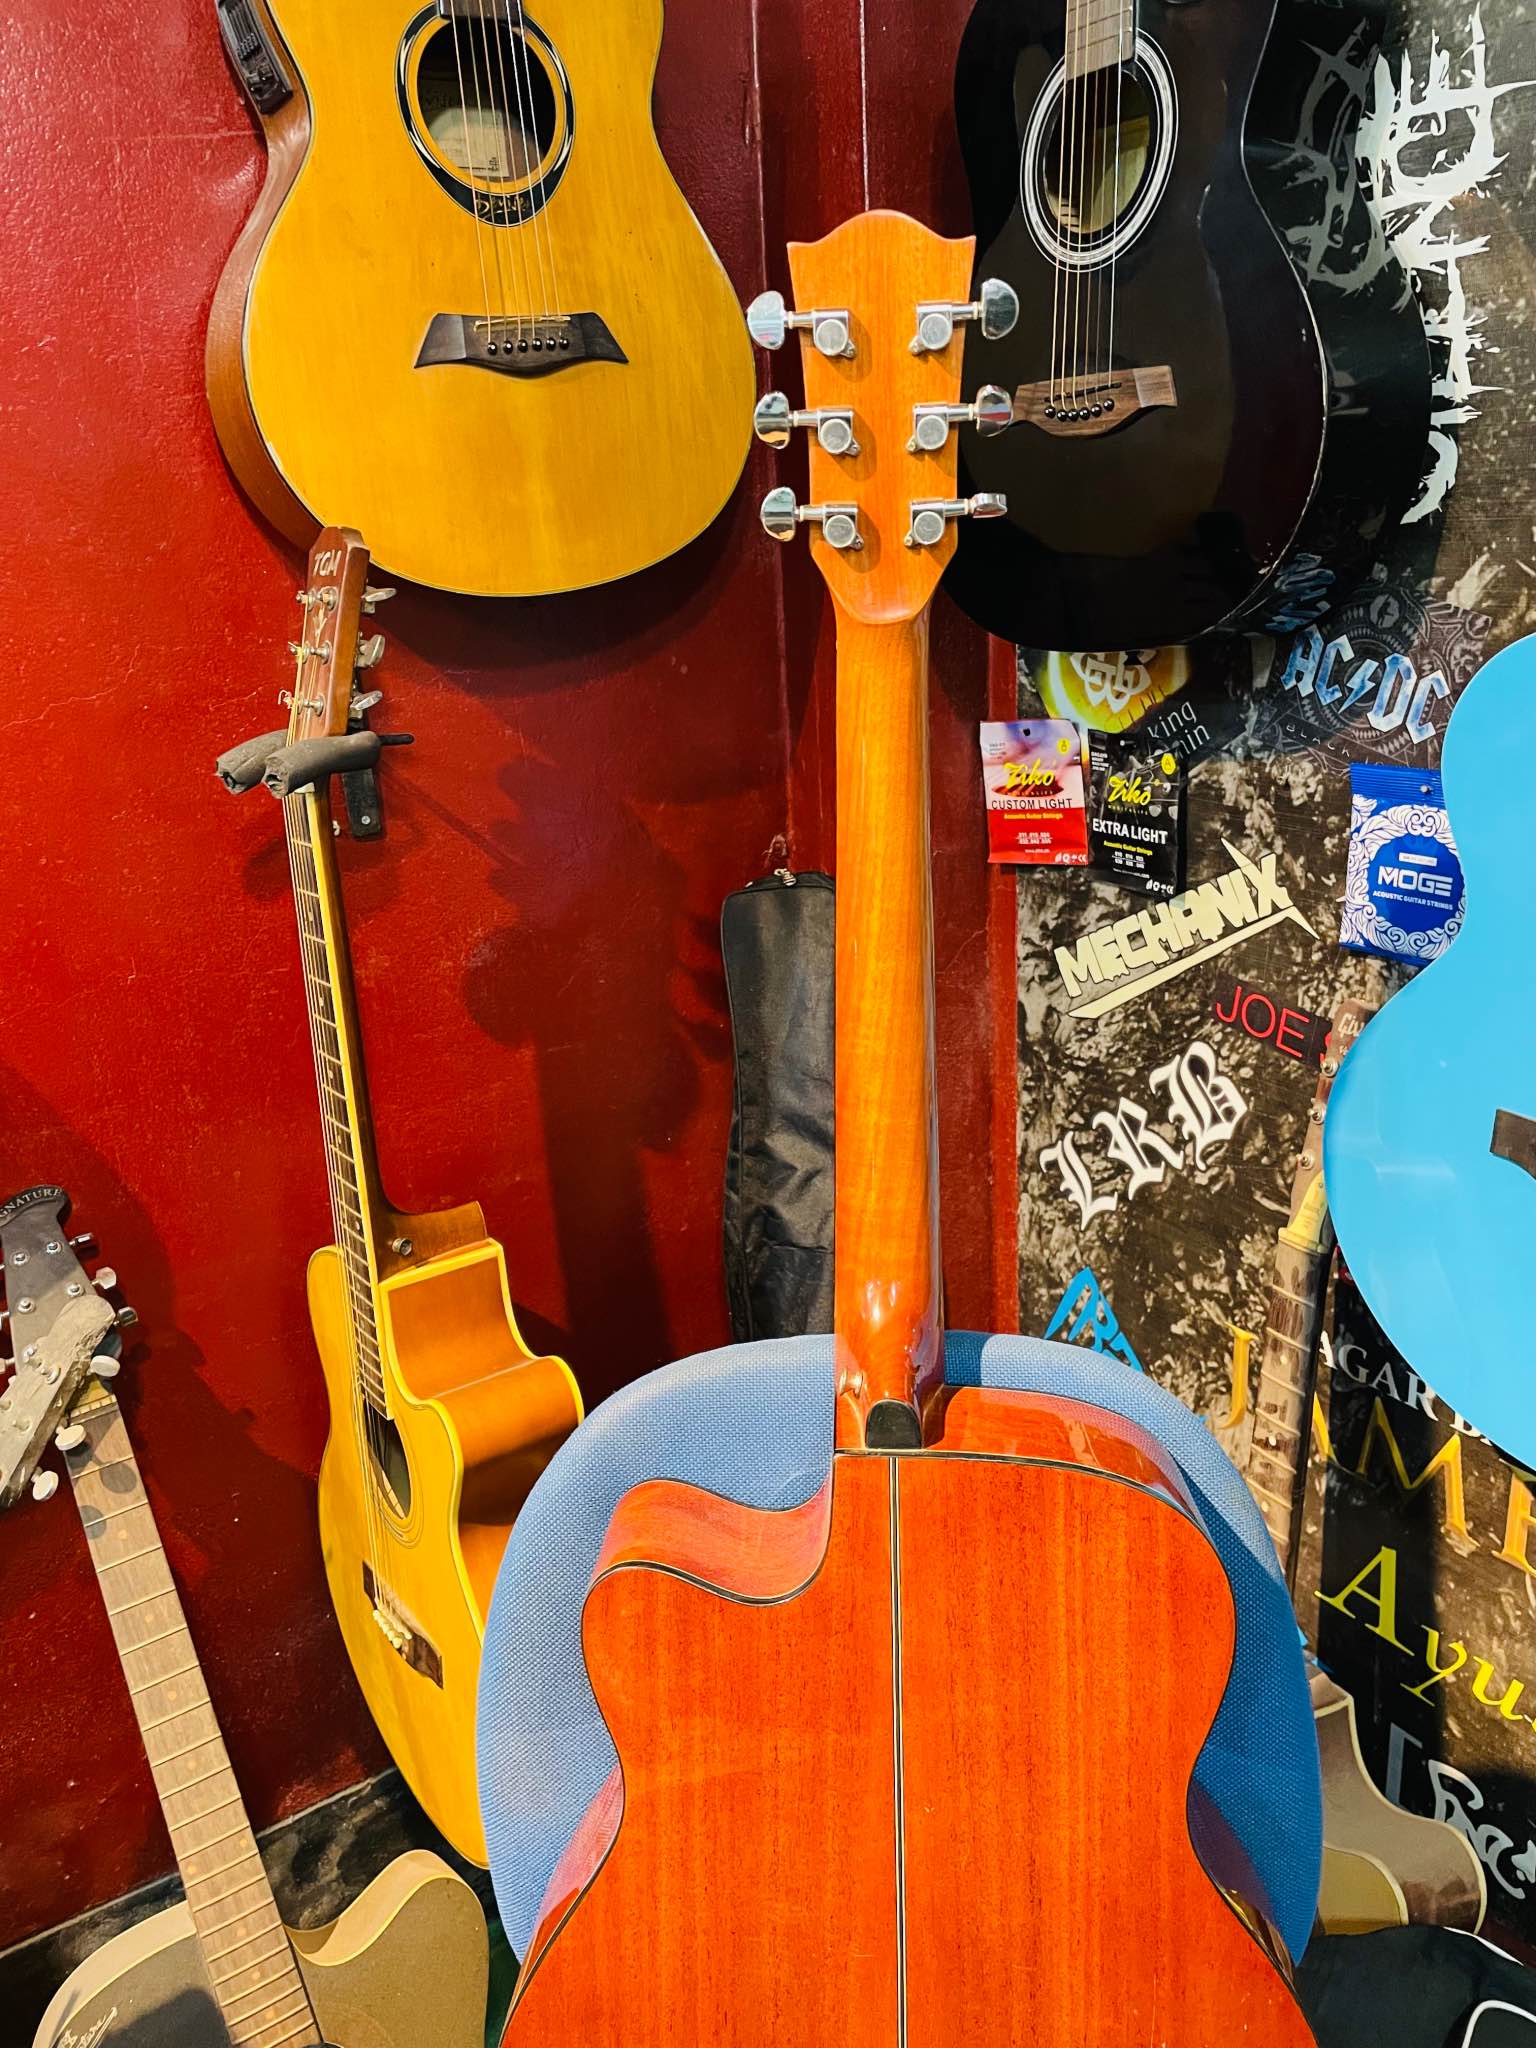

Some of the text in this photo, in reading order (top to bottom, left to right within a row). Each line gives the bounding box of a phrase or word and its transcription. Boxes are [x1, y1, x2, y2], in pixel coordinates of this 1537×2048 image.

[991, 798, 1073, 810] CUSTOM LIGHT
[1108, 776, 1151, 806] Ziko
[1092, 818, 1169, 845] EXTRA LIGHT
[1377, 866, 1454, 897] MOGE
[1372, 890, 1454, 911] ACOUSTIC GUITAR STRINGS
[1053, 845, 1296, 999] MECHANIX
[1215, 985, 1311, 1058] JOE
[1314, 1545, 1537, 1734] Ayu
